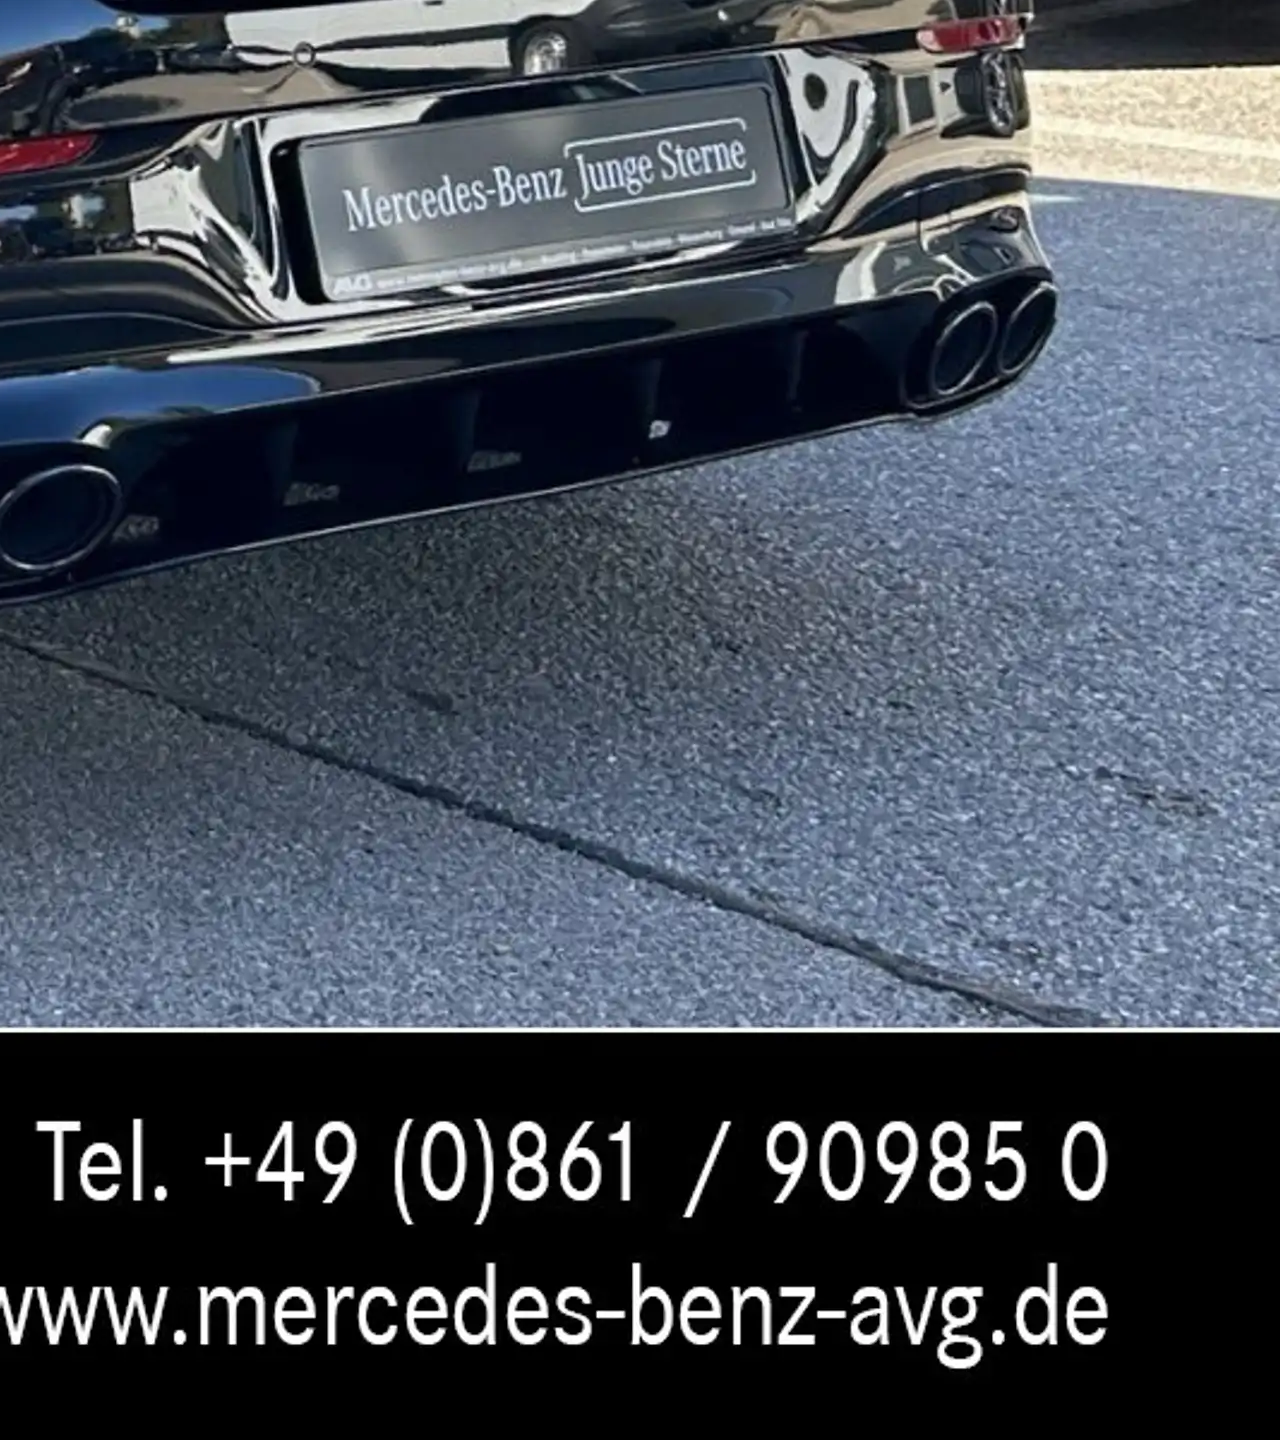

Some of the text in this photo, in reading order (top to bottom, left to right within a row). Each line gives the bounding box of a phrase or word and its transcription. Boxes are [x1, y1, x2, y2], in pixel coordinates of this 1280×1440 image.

[342, 138, 748, 232] Mercedes-Benz Junge Sterne
